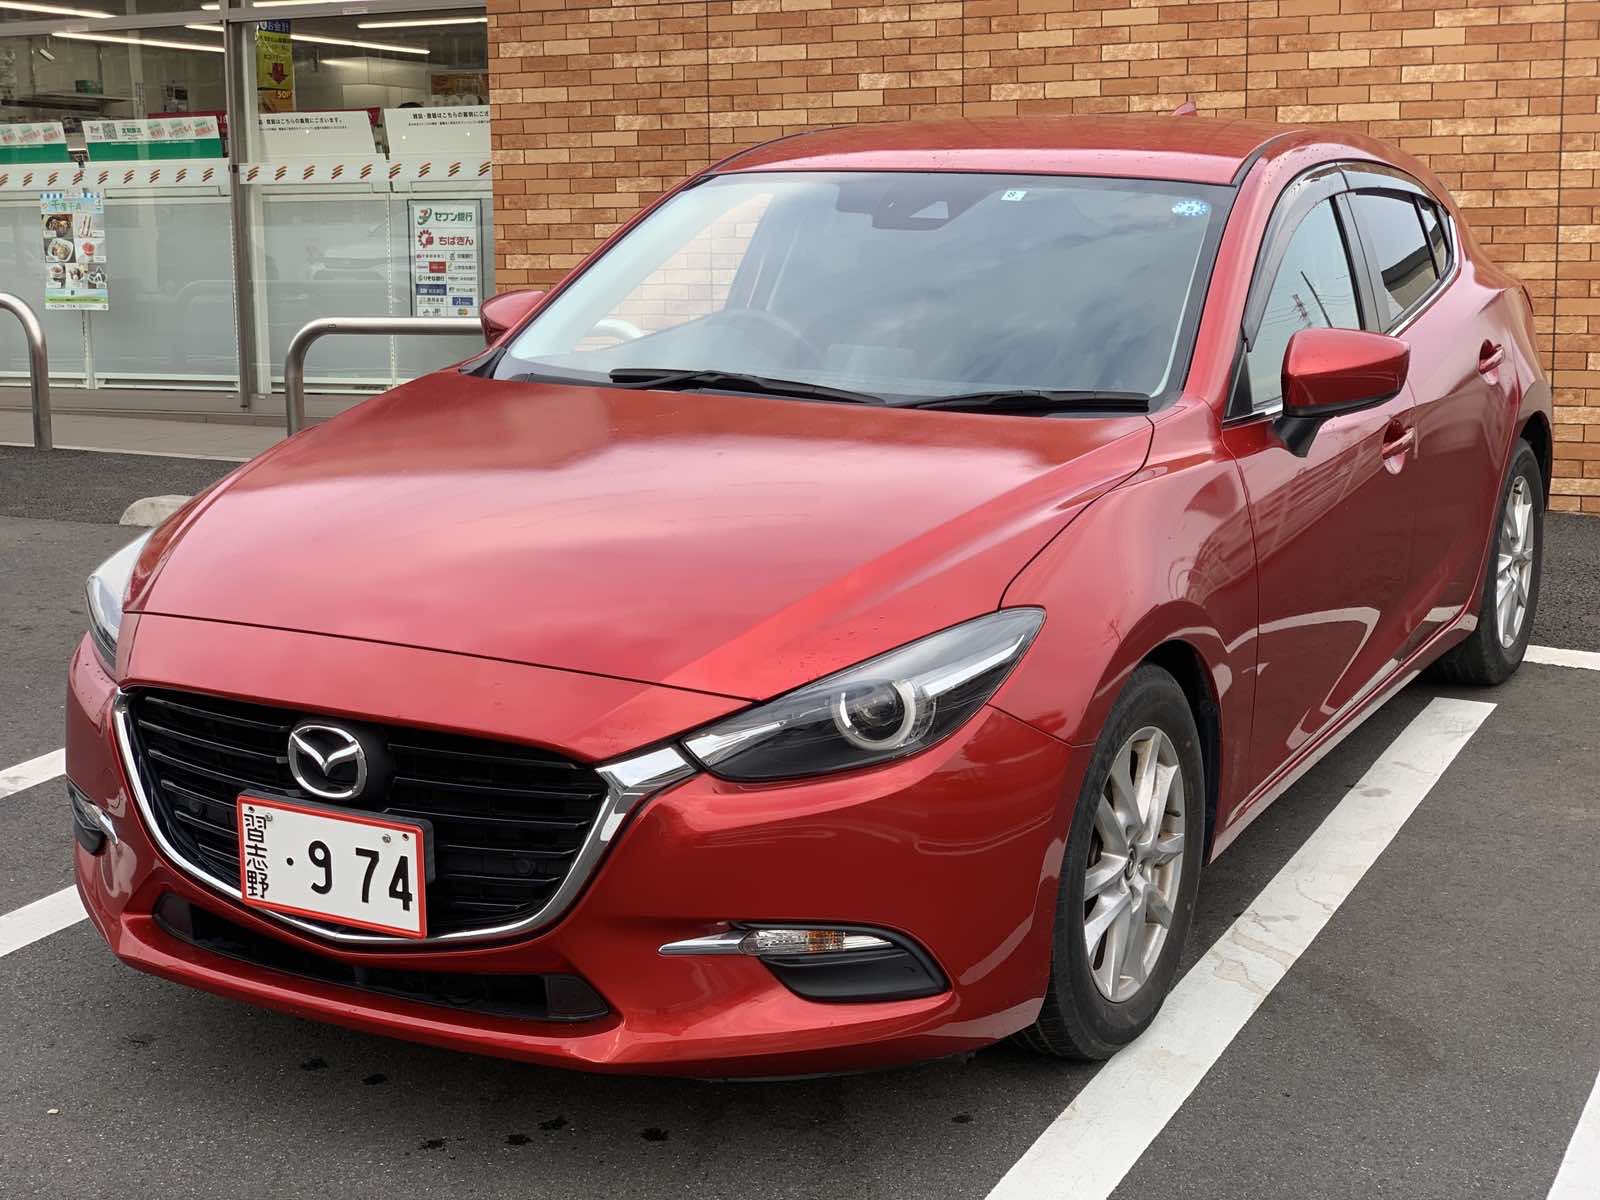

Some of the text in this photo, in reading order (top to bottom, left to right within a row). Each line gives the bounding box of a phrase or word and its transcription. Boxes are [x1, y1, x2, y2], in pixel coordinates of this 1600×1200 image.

[434, 211, 473, 222] セブン銀行
[438, 236, 474, 246] ちばぎん
[243, 813, 269, 899] 習志野
